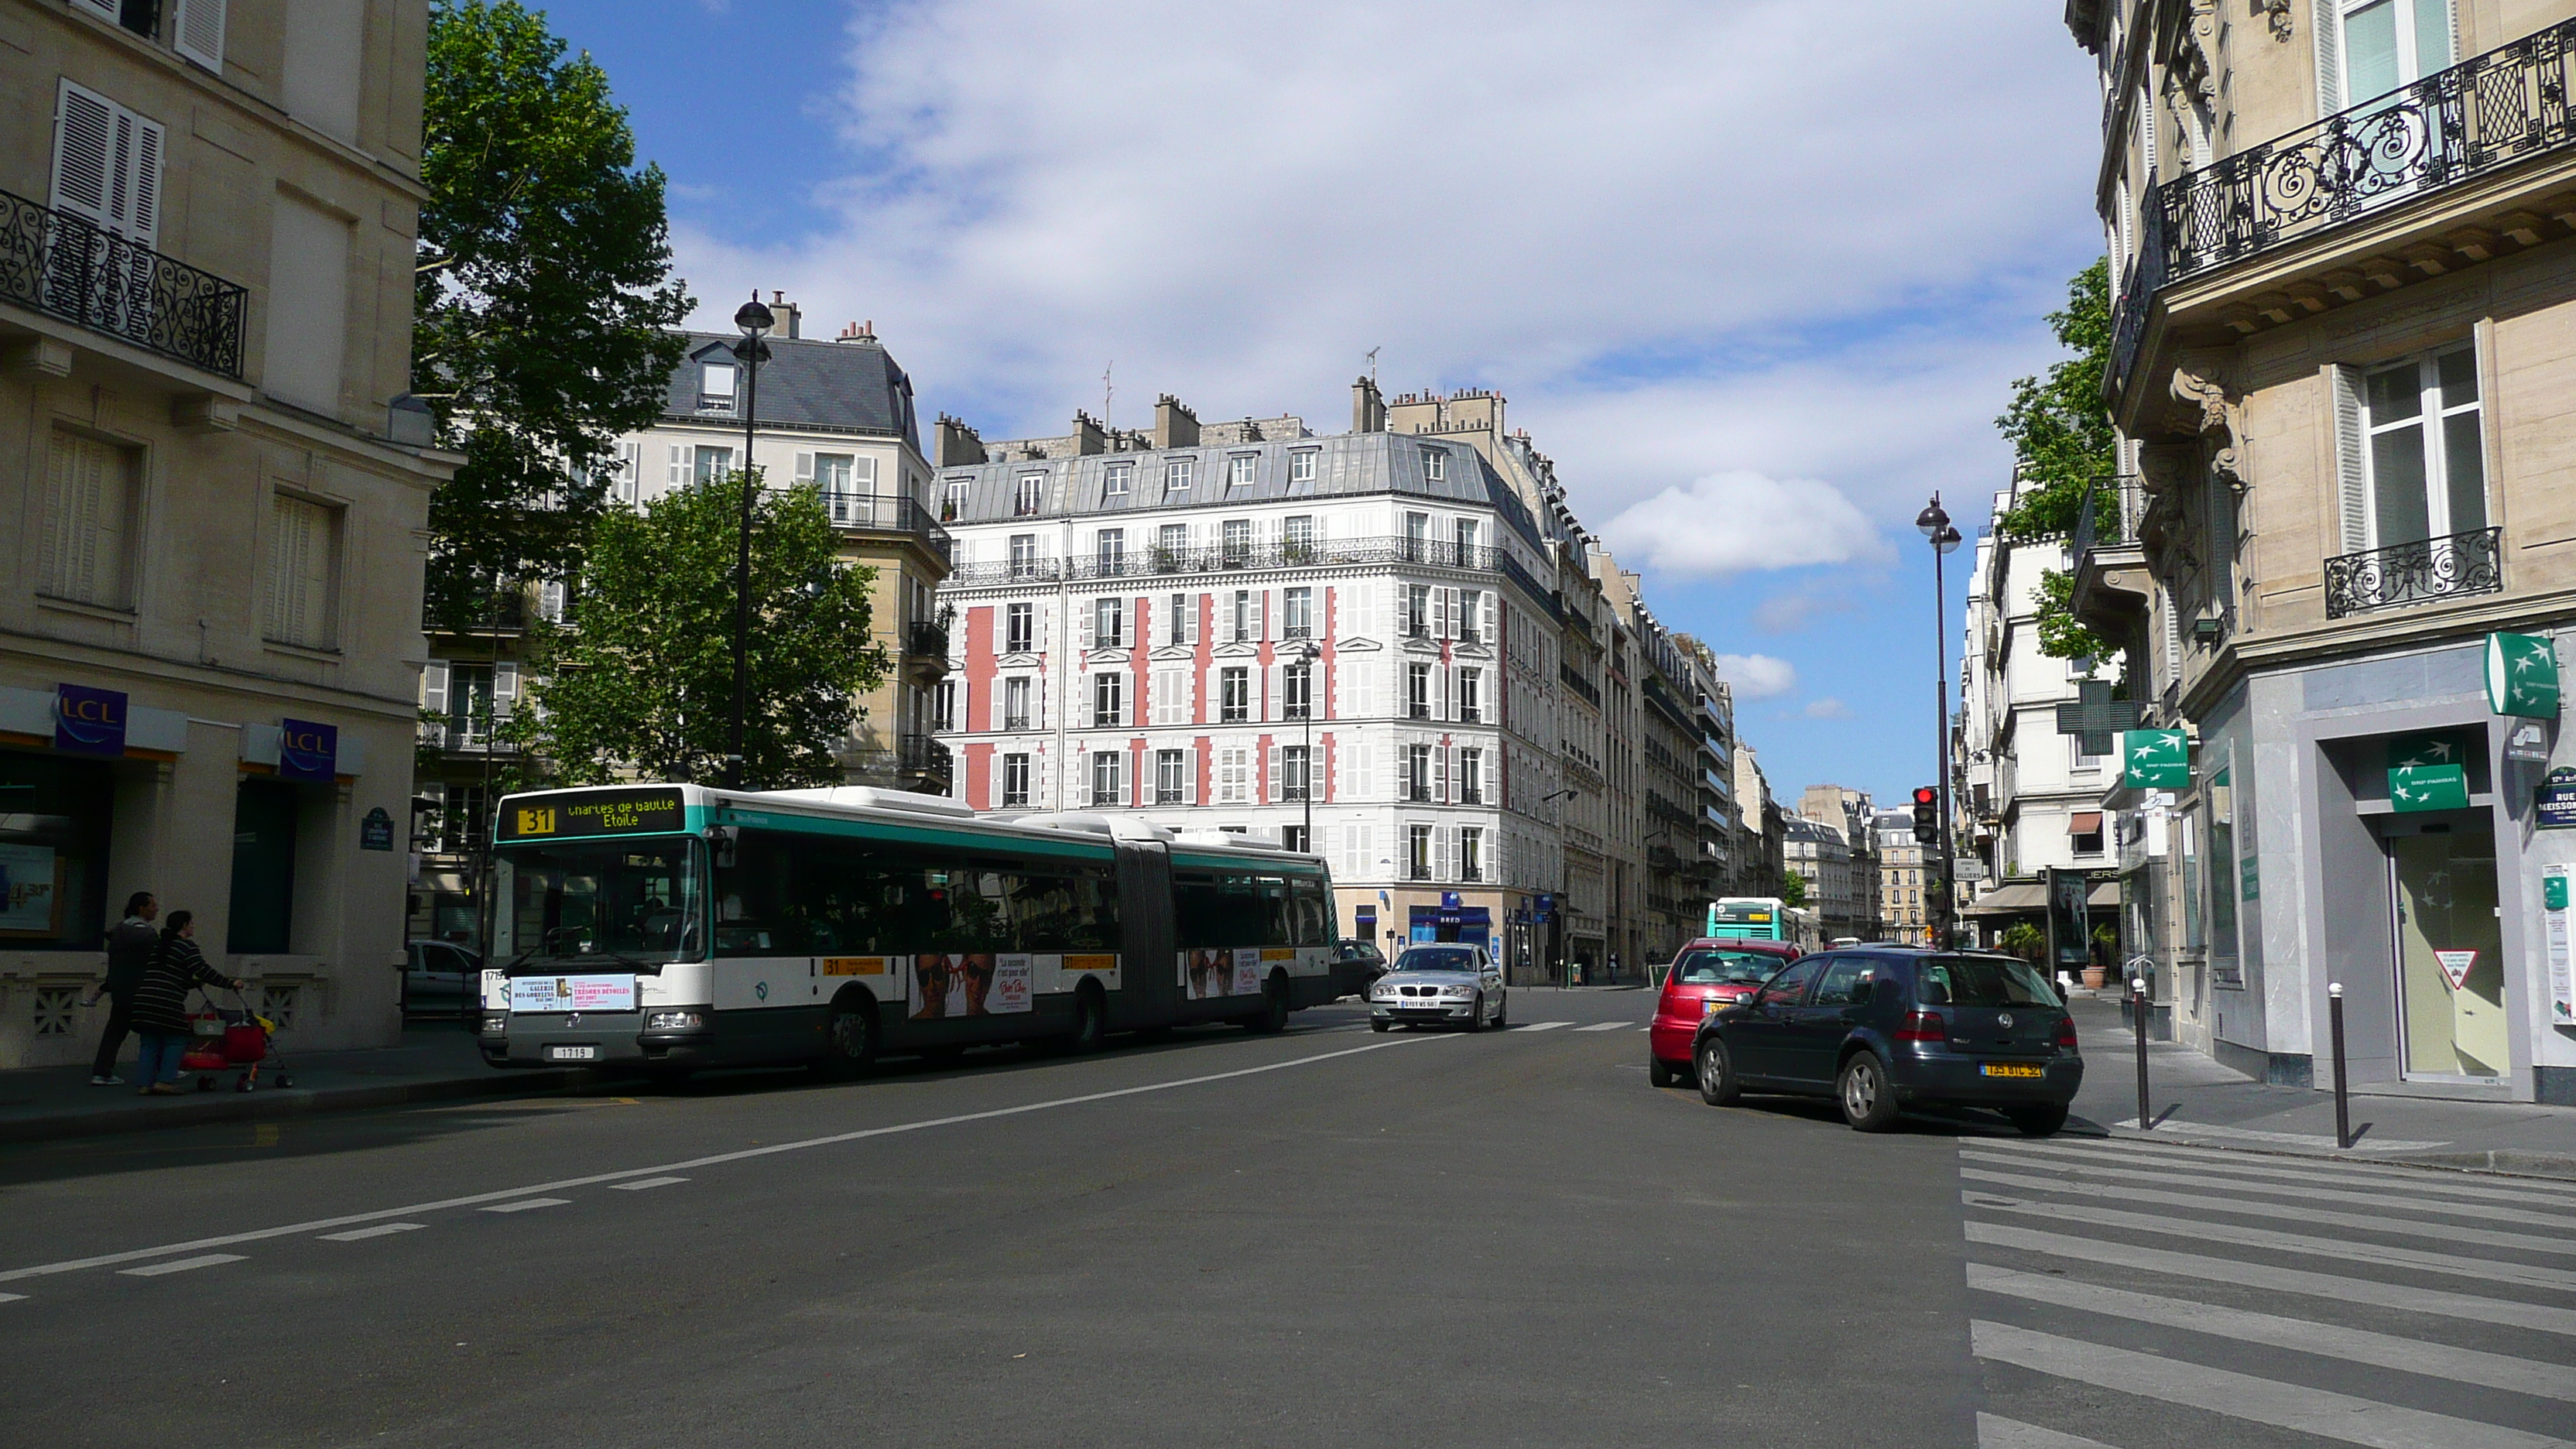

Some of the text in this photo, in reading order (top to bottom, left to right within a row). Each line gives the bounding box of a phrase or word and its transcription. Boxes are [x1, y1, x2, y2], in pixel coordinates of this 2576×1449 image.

[63, 697, 118, 724] LCL
[286, 730, 330, 754] LCL
[2556, 793, 2576, 801] RUE
[568, 798, 675, 816] Charles de Gaulle
[527, 809, 549, 831] 31
[604, 813, 639, 828] Etoile
[827, 960, 838, 975] 31
[601, 987, 630, 995] DÉVOILÉS
[561, 1048, 585, 1057] 1719
